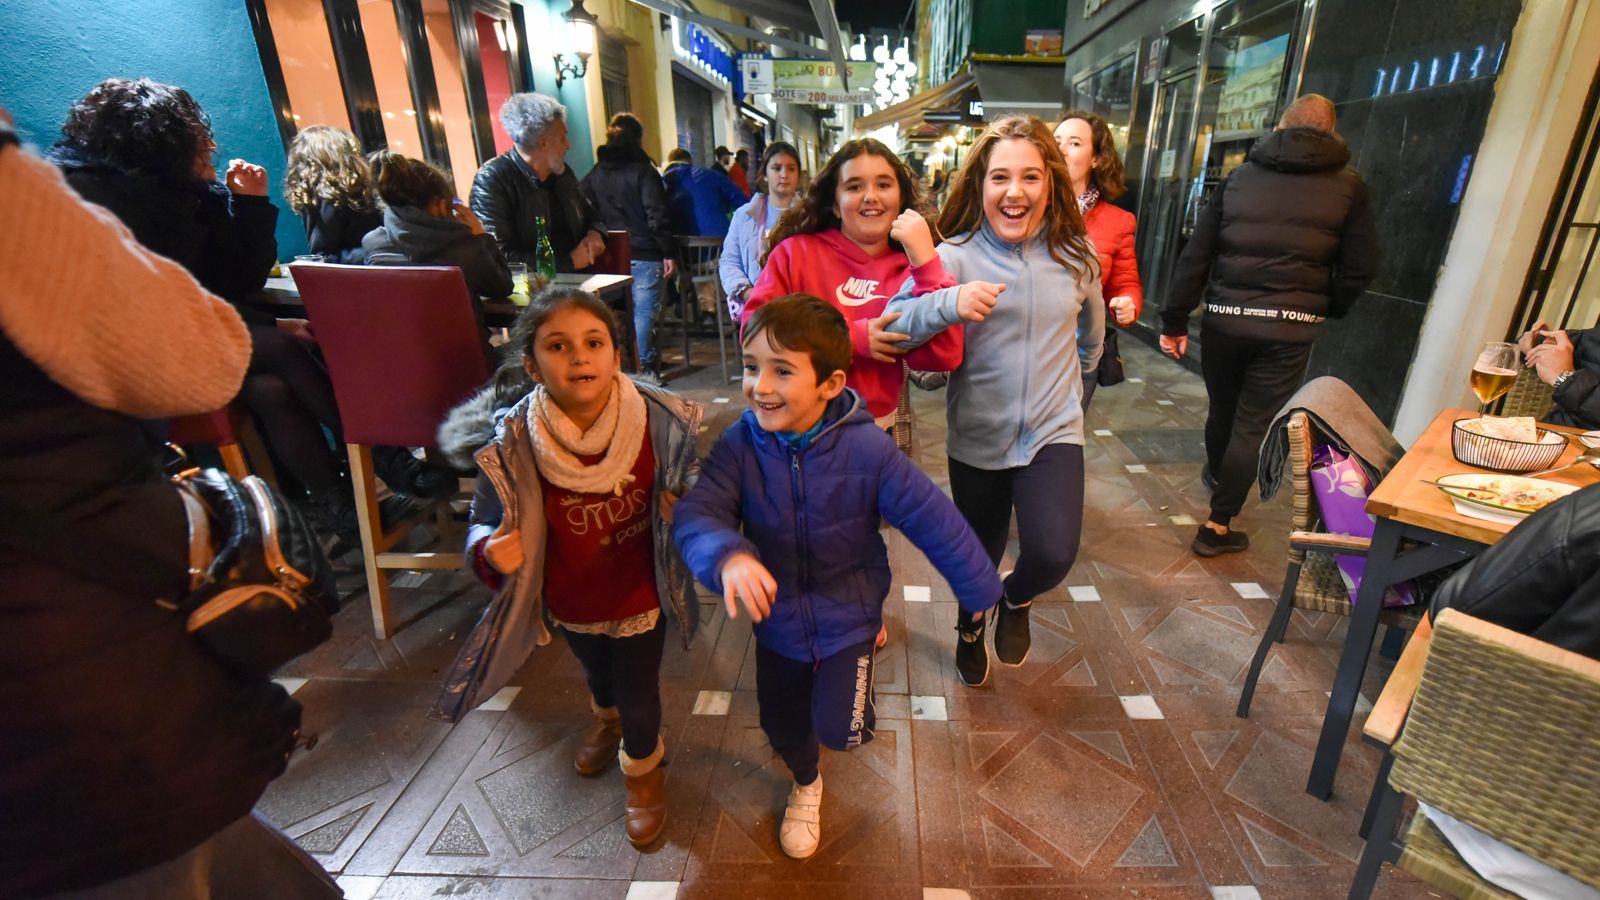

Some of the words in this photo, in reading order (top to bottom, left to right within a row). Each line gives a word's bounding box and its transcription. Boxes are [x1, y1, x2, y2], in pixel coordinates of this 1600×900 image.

[808, 92, 827, 102] 200
[843, 276, 880, 298] NIKE
[1208, 303, 1241, 315] YOUNG
[1282, 310, 1316, 323] YOUNG
[850, 654, 870, 732] WINNING
